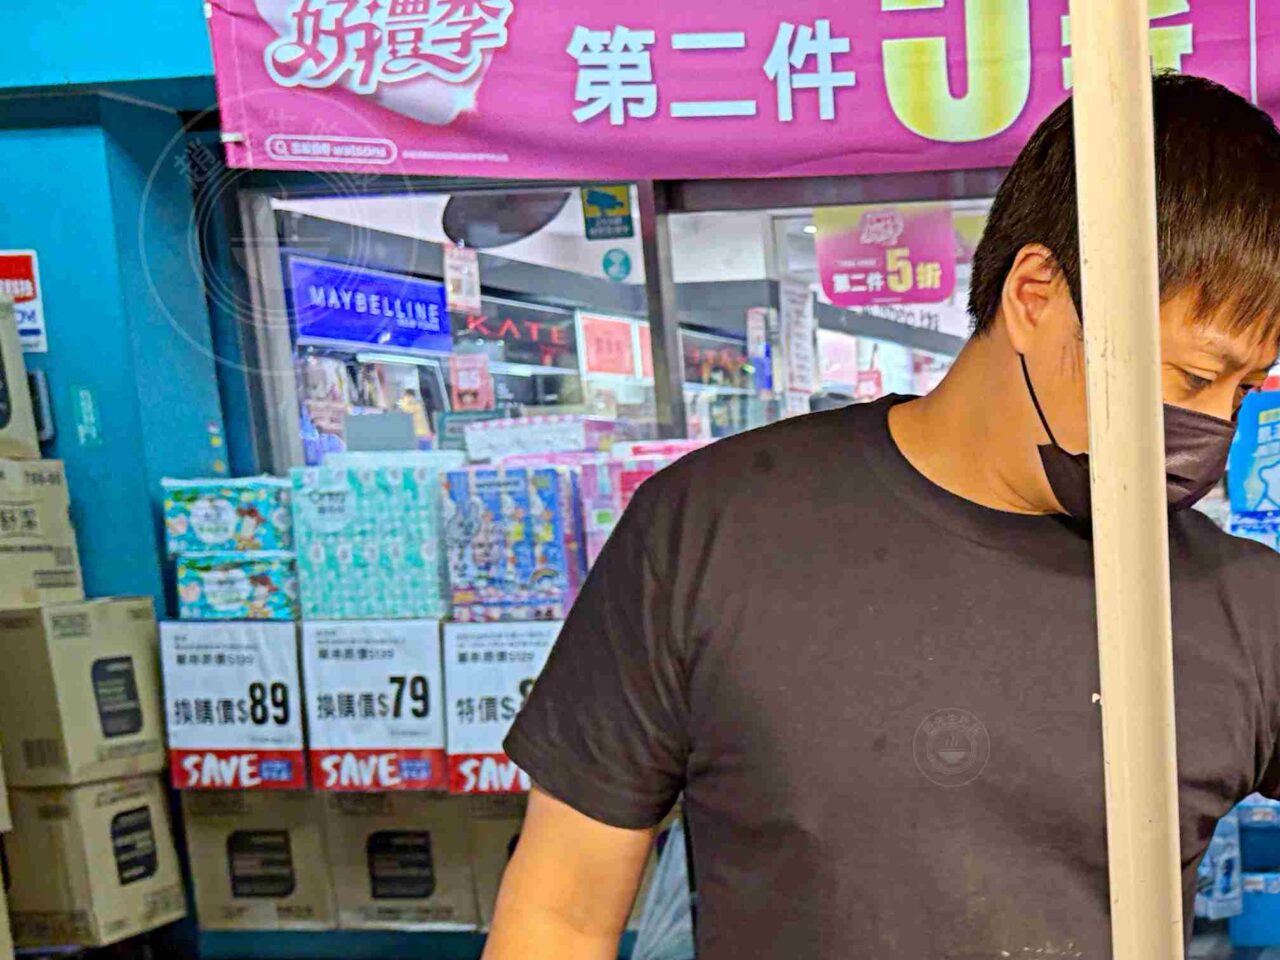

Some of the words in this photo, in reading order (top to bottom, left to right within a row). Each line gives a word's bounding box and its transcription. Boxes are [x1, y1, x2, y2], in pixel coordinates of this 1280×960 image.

[308, 284, 440, 319] MAYBELLINE
[465, 314, 568, 344] KATE
[181, 753, 262, 788] SAVE
[320, 752, 402, 788] SAVE
